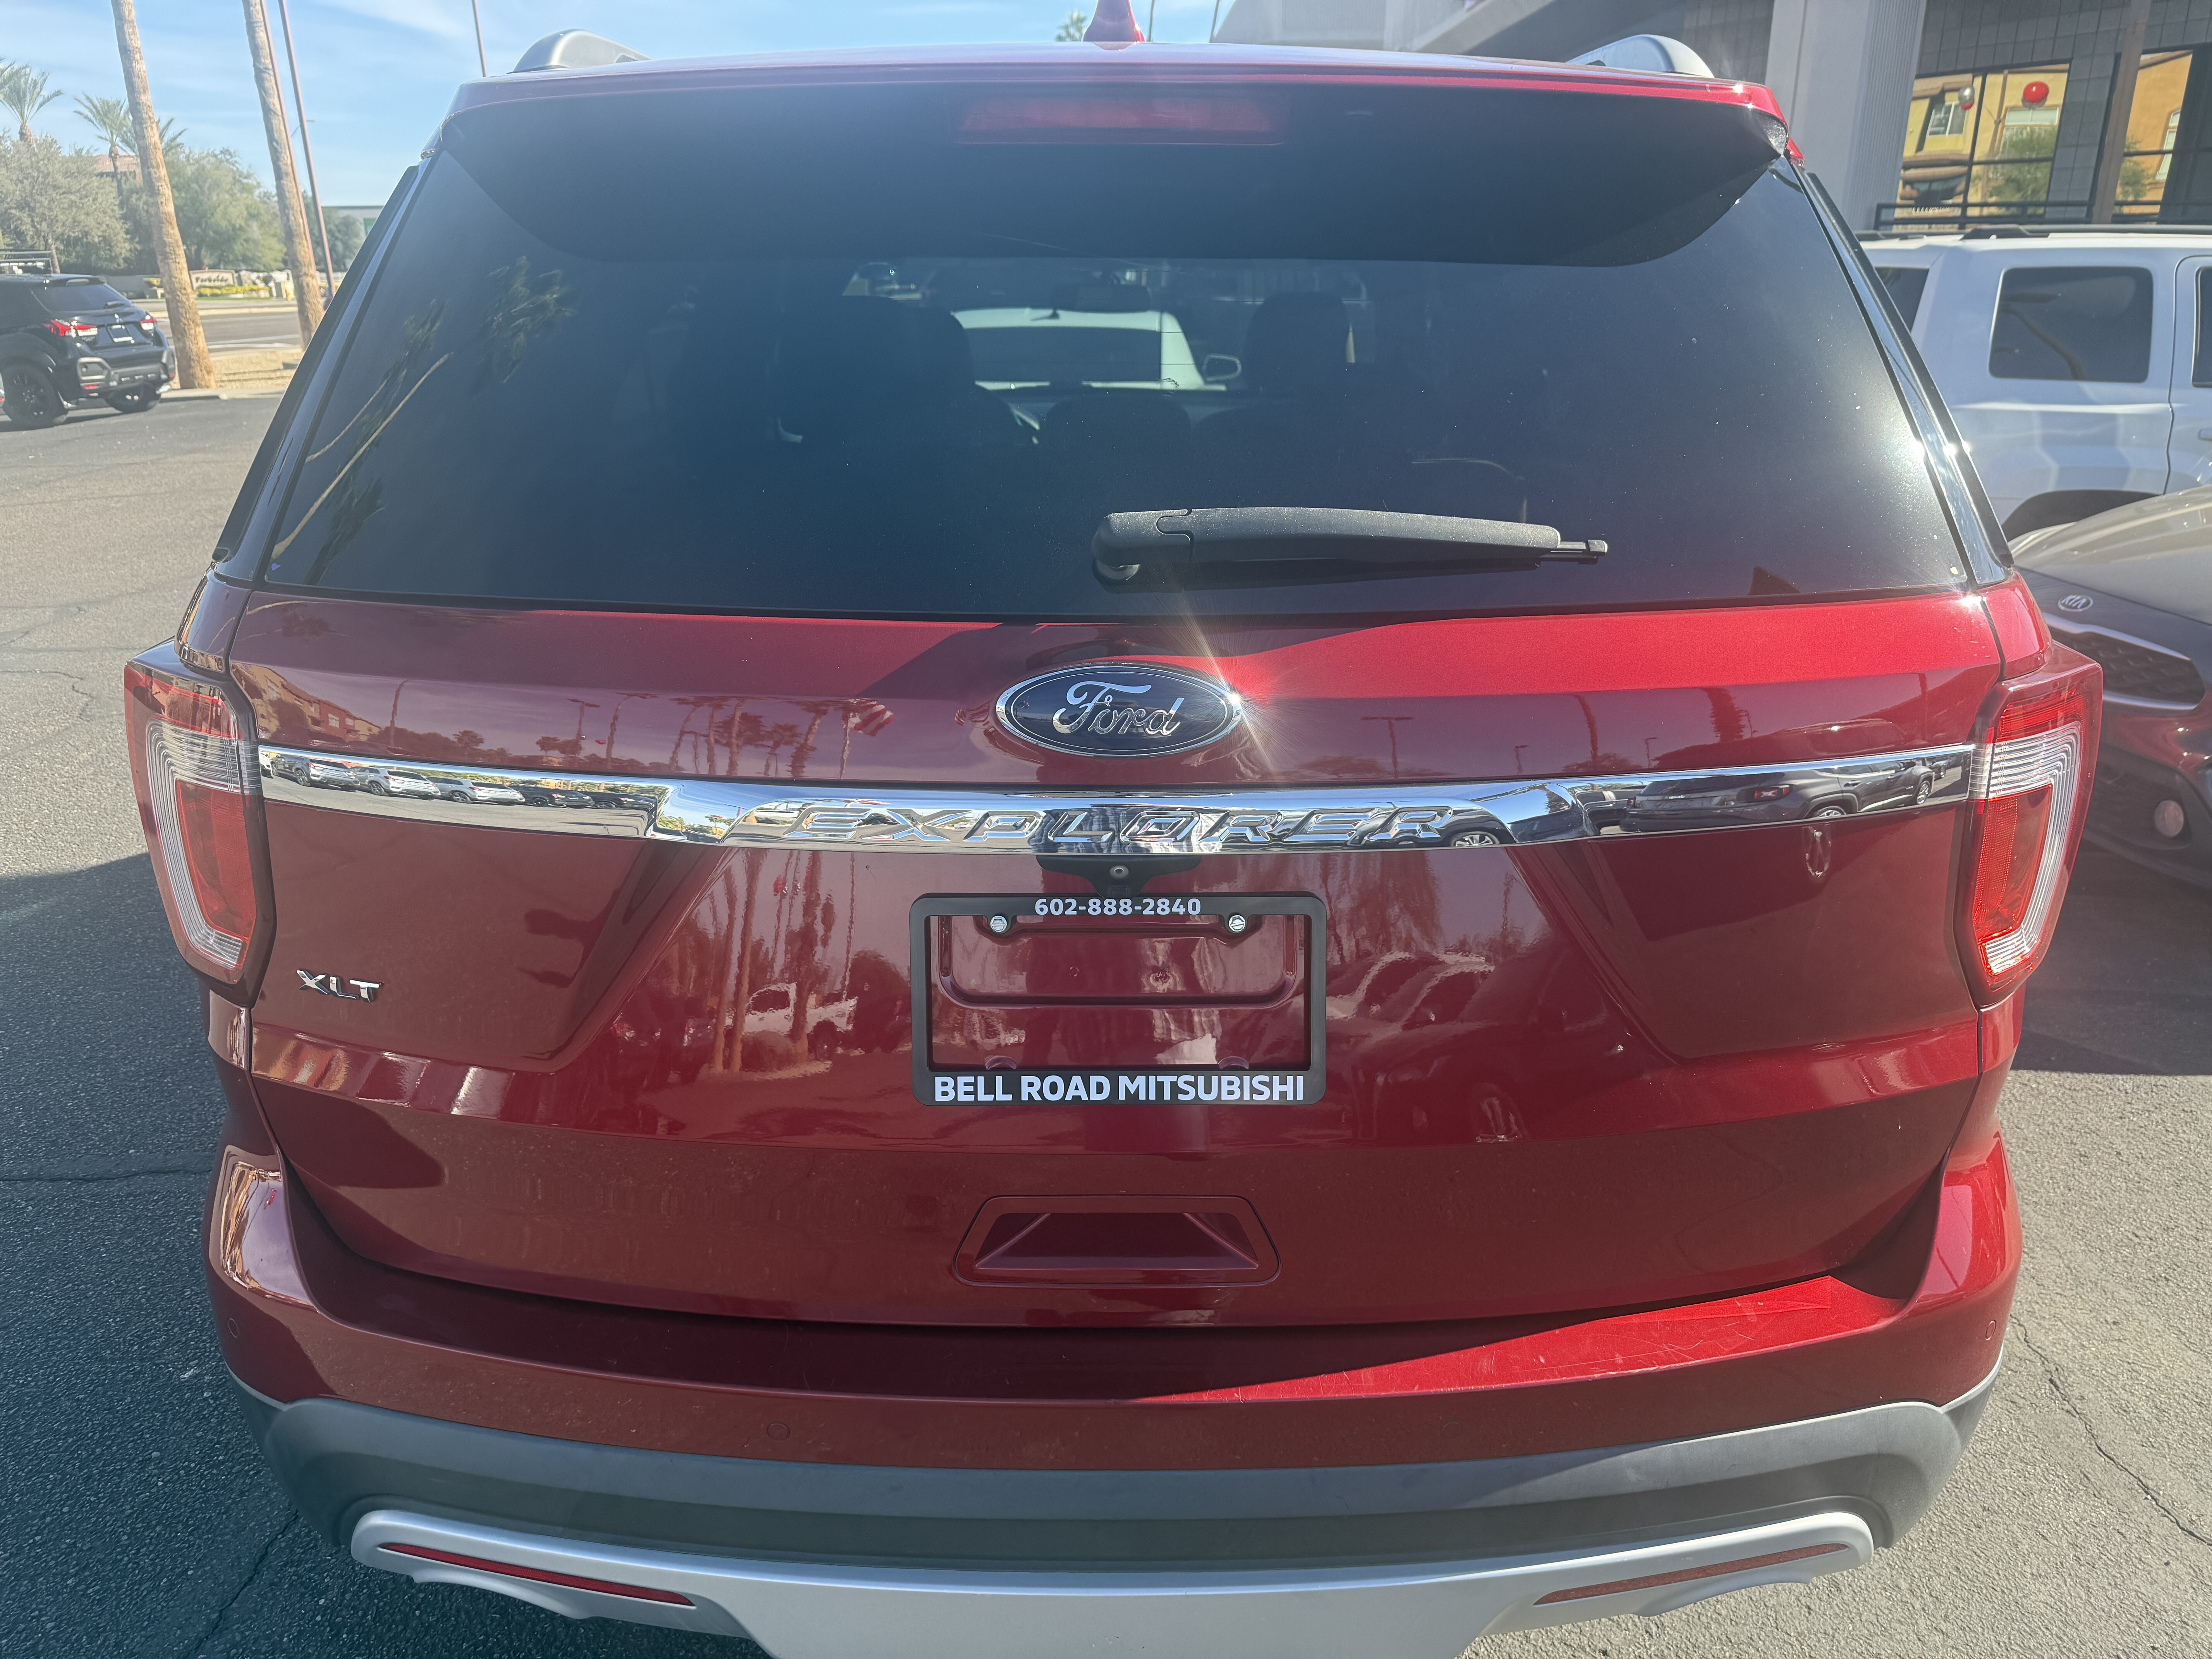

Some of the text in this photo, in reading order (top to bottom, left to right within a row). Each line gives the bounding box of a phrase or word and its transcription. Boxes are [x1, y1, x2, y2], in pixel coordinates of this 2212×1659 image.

[2061, 595, 2087, 609] KIA
[1053, 681, 1184, 735] Ford
[783, 806, 1453, 843] EXPLORER
[1035, 898, 1201, 915] 602-888-2840
[296, 969, 383, 1002] XLT
[935, 1075, 1304, 1102] BELL ROAD MITSUBISHI
